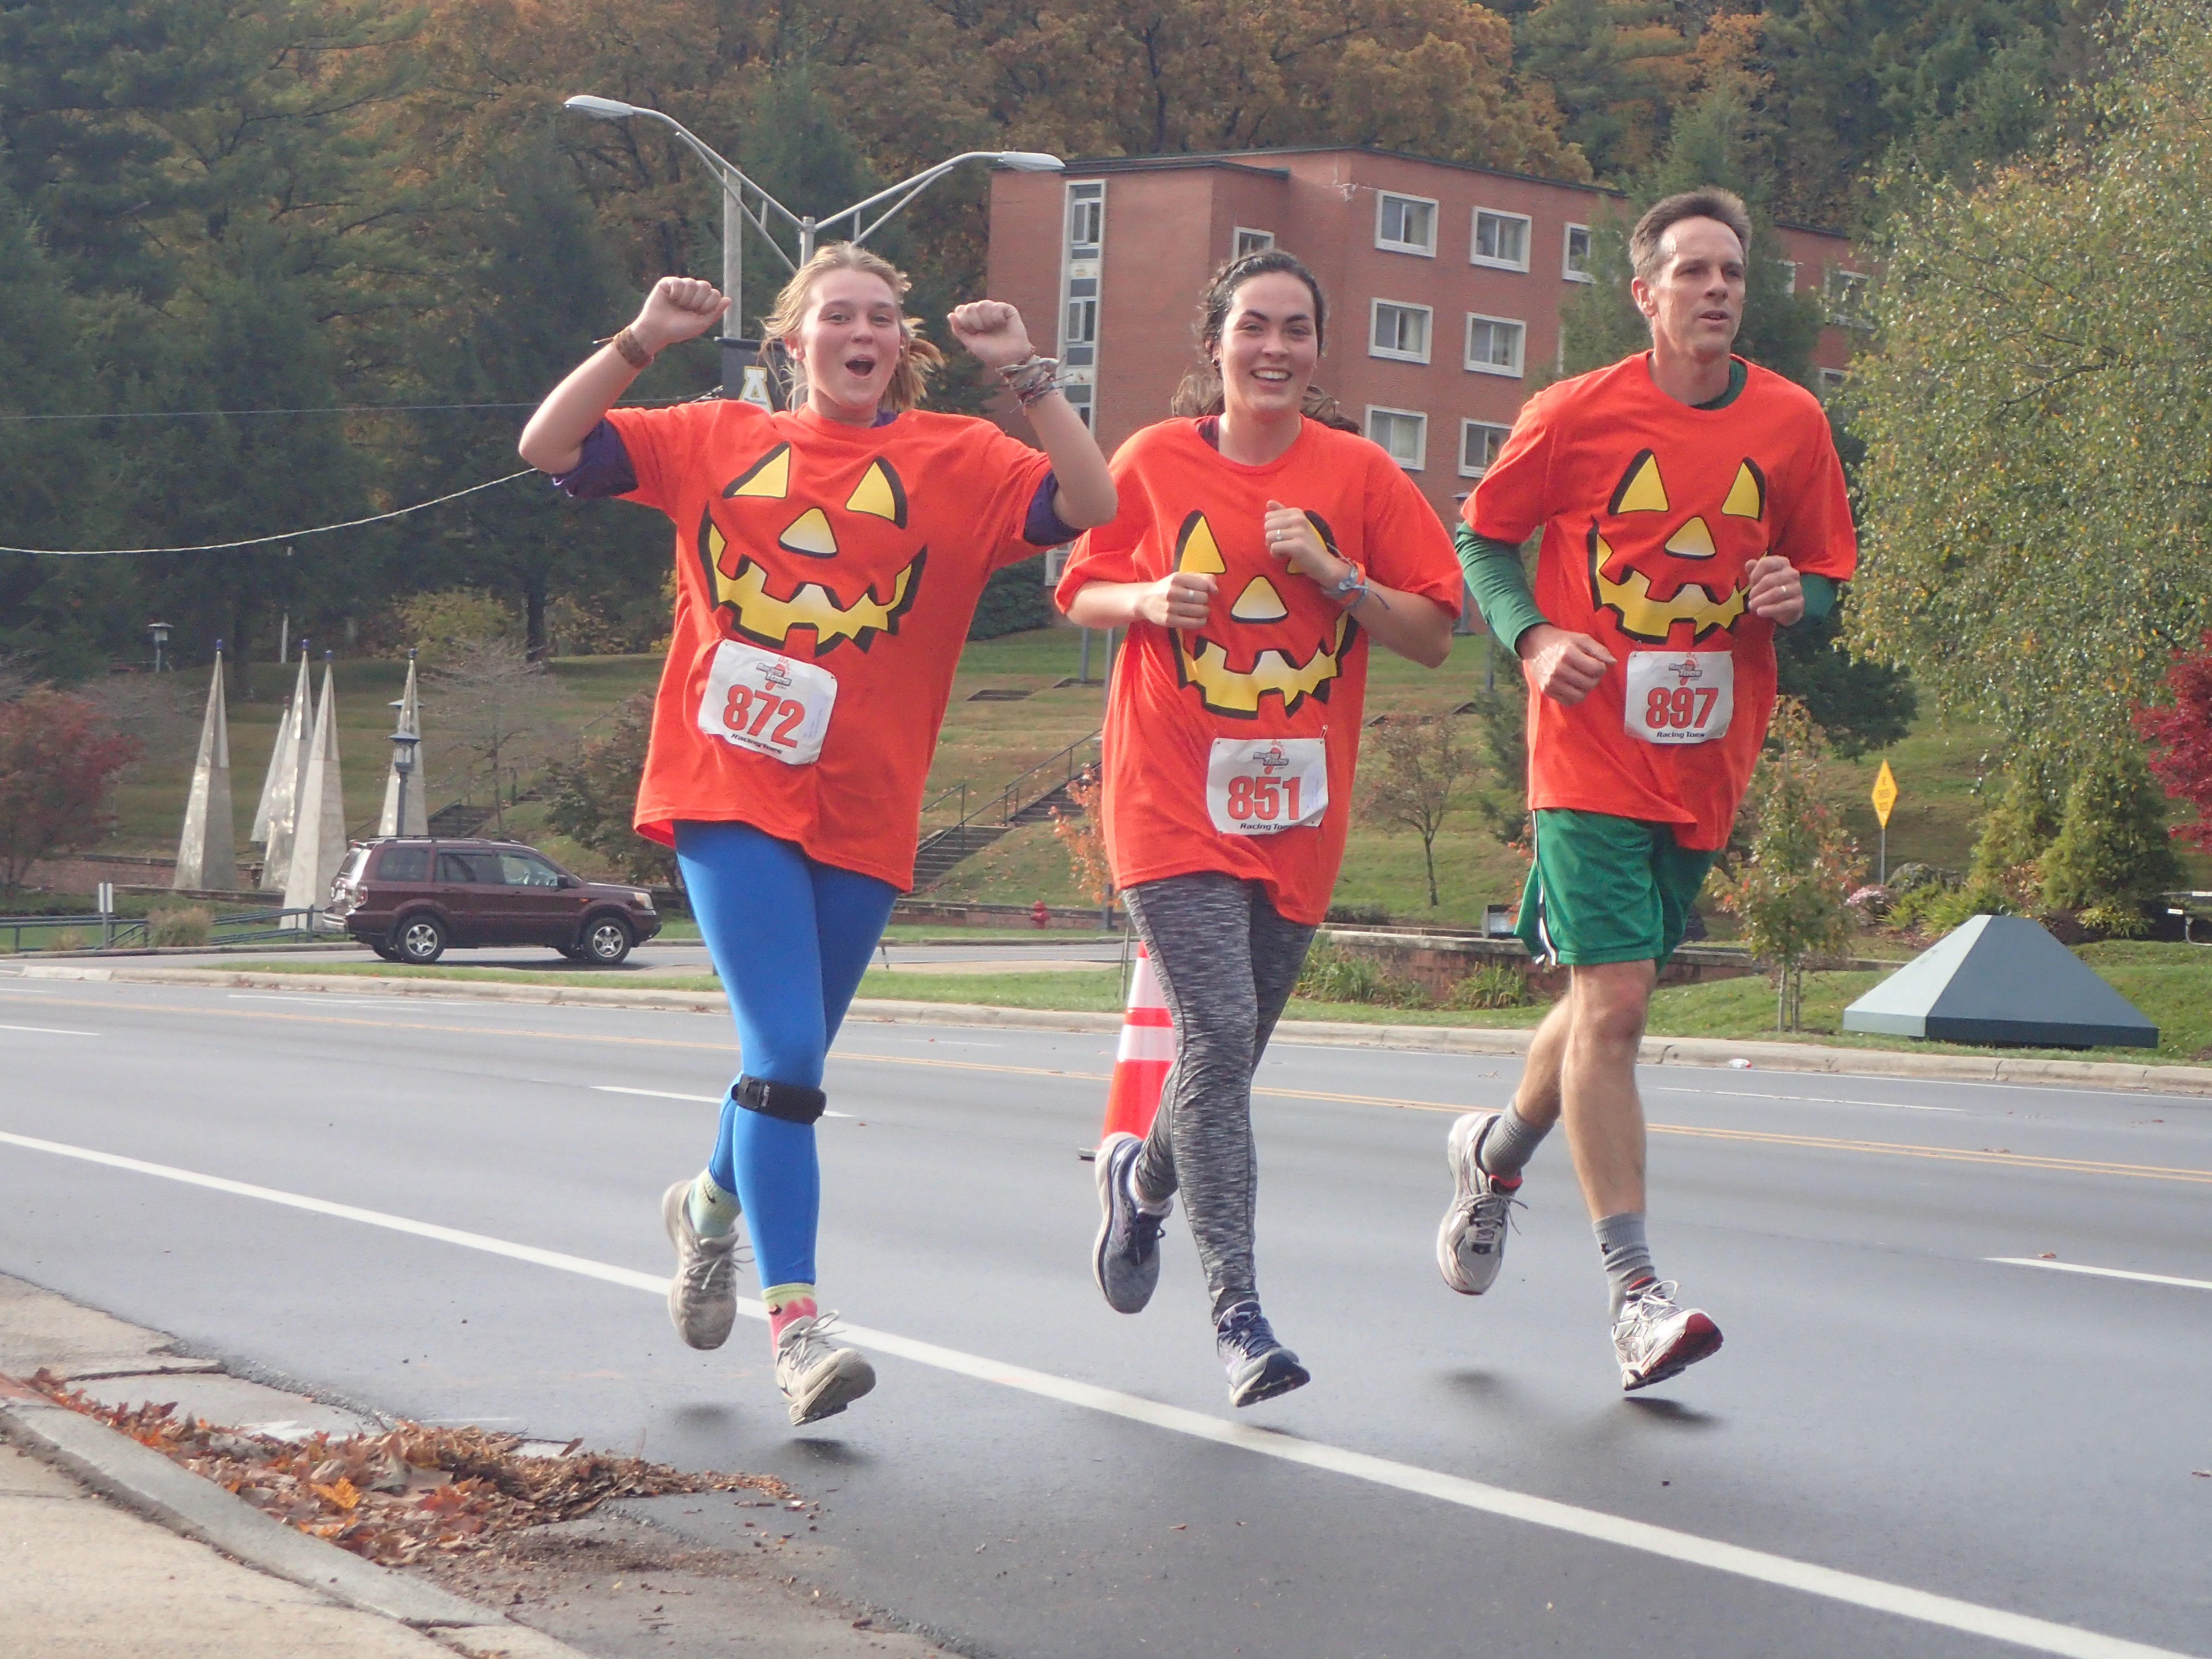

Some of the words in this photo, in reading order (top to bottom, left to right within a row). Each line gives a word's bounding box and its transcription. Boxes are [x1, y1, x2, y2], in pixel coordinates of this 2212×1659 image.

[723, 684, 805, 748] 872
[1646, 687, 1719, 729] 897
[731, 733, 761, 747] Racing
[1227, 775, 1301, 820] 851
